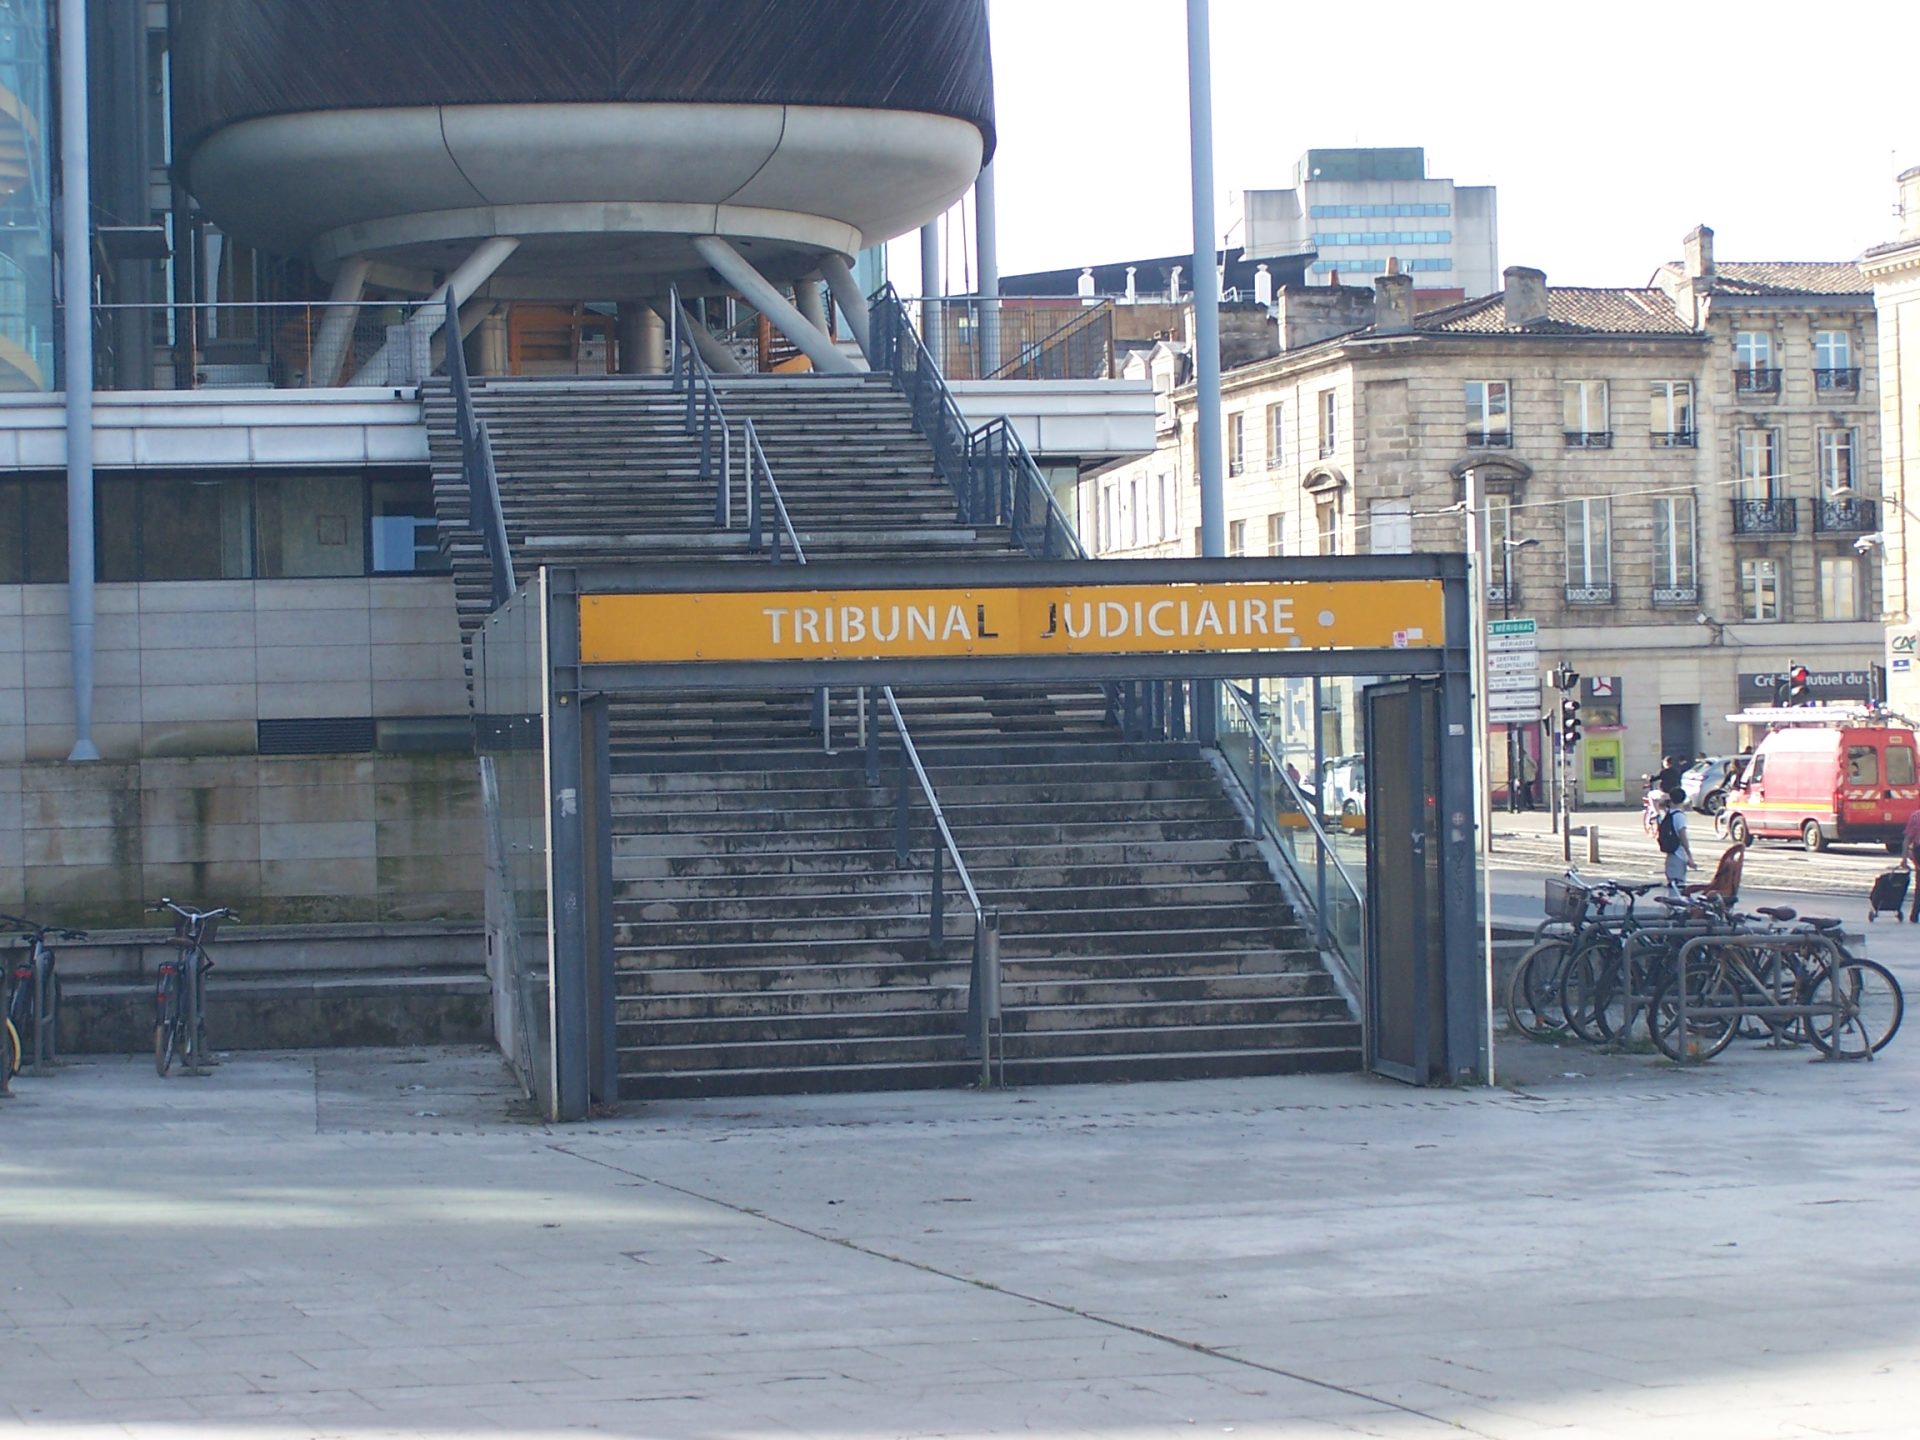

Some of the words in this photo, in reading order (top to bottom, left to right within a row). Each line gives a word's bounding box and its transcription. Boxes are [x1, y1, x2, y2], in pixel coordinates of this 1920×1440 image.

[763, 604, 999, 644] TRIBUNAL
[1040, 598, 1296, 638] JUDICIAIRE
[1495, 622, 1534, 633] MÉRIGNAC
[1846, 673, 1863, 685] du
